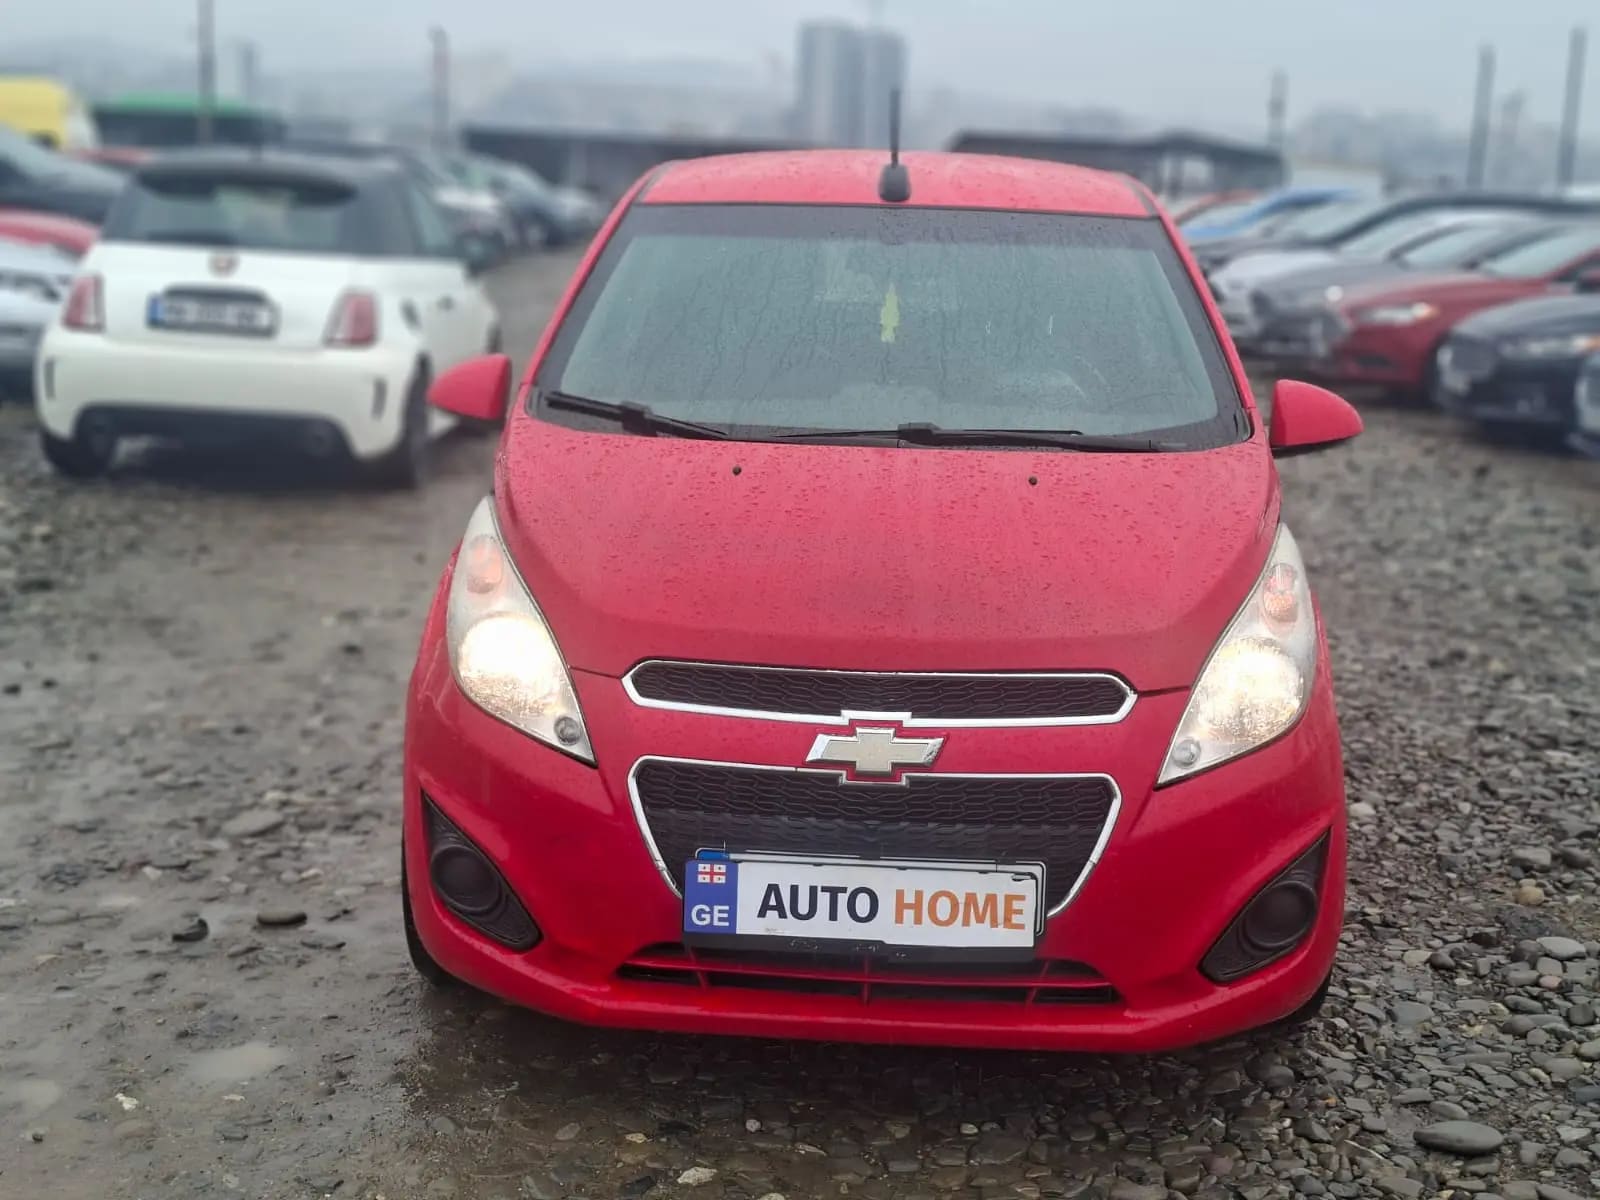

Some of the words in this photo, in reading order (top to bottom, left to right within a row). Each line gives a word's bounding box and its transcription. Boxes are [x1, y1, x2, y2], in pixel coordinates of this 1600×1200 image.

[691, 904, 730, 927] GE
[757, 883, 879, 923] AUTO
[894, 889, 1027, 930] HOME
